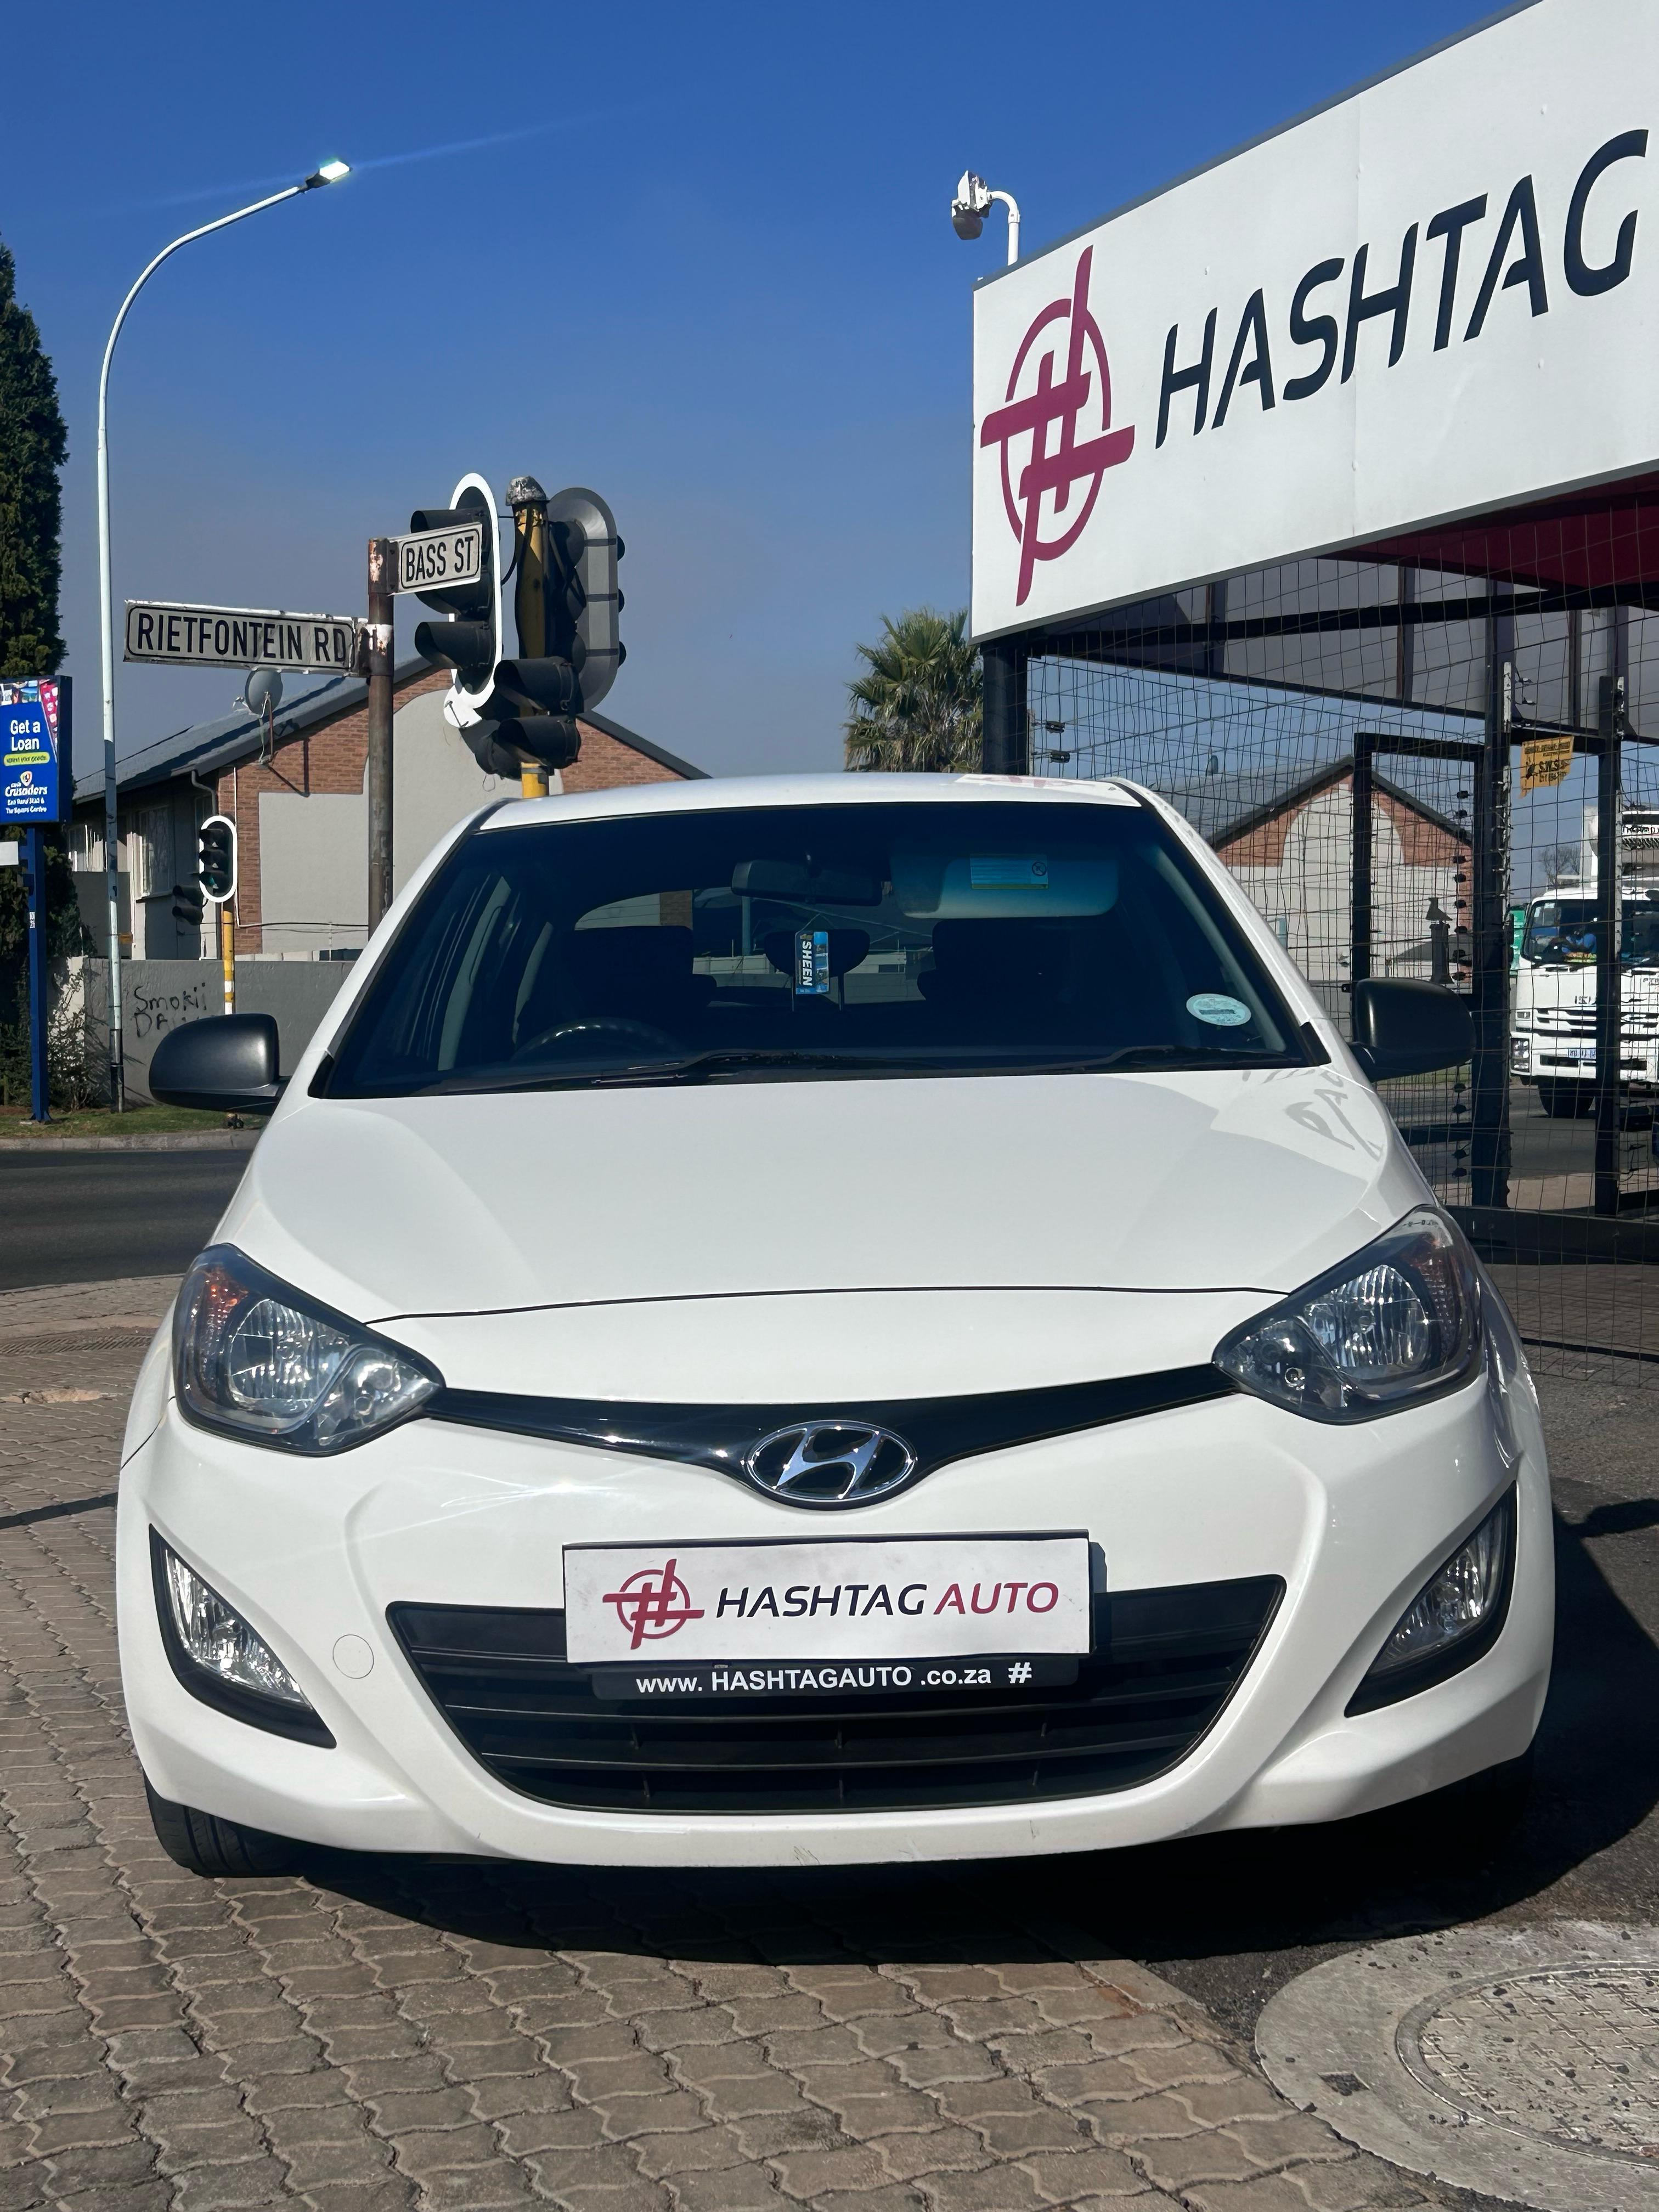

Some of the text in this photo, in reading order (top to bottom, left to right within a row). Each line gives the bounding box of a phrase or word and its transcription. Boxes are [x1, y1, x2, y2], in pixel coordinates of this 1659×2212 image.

[1155, 128, 1649, 450] HASHTAG
[406, 535, 475, 583] BASS ST
[137, 612, 348, 663] RIETFONTEIN RD
[10, 719, 41, 735] Get a
[11, 737, 40, 752] Loan
[802, 940, 812, 986] SHEEN
[715, 1582, 1059, 1618] HASHTAG AUTO
[636, 1677, 702, 1694] www.
[712, 1666, 912, 1691] HASHTAGAUTO
[920, 1669, 992, 1686] .co.za
